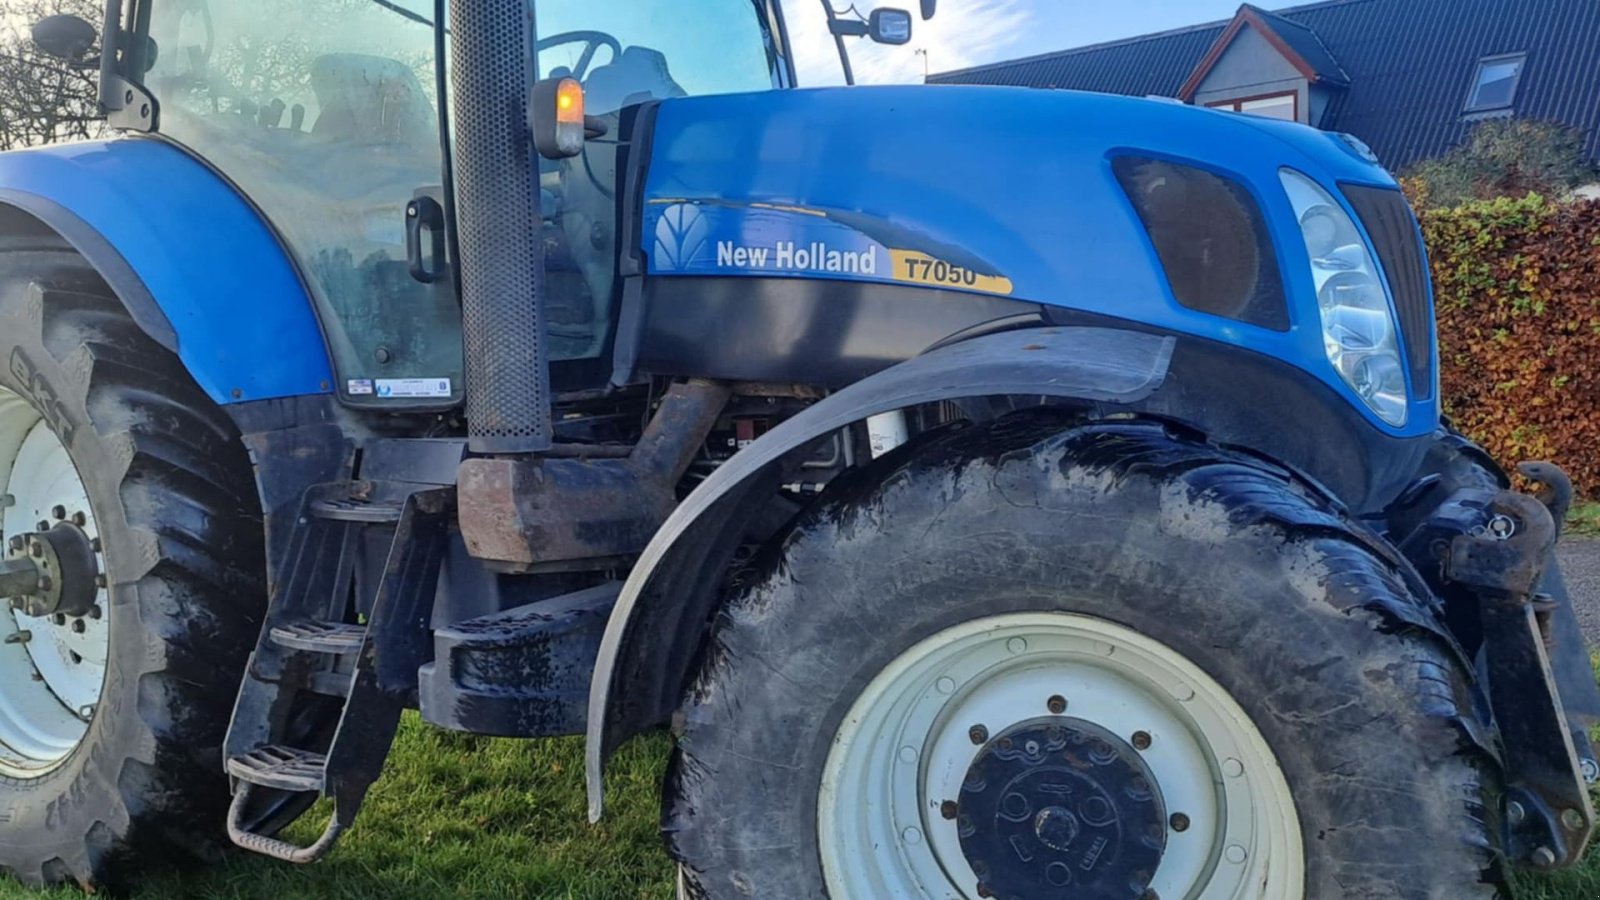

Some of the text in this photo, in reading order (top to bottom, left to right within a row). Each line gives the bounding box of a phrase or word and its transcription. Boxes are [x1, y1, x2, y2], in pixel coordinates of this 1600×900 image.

[717, 241, 876, 274] New Holland
[904, 258, 977, 286] T7050
[10, 345, 75, 449] BKT
